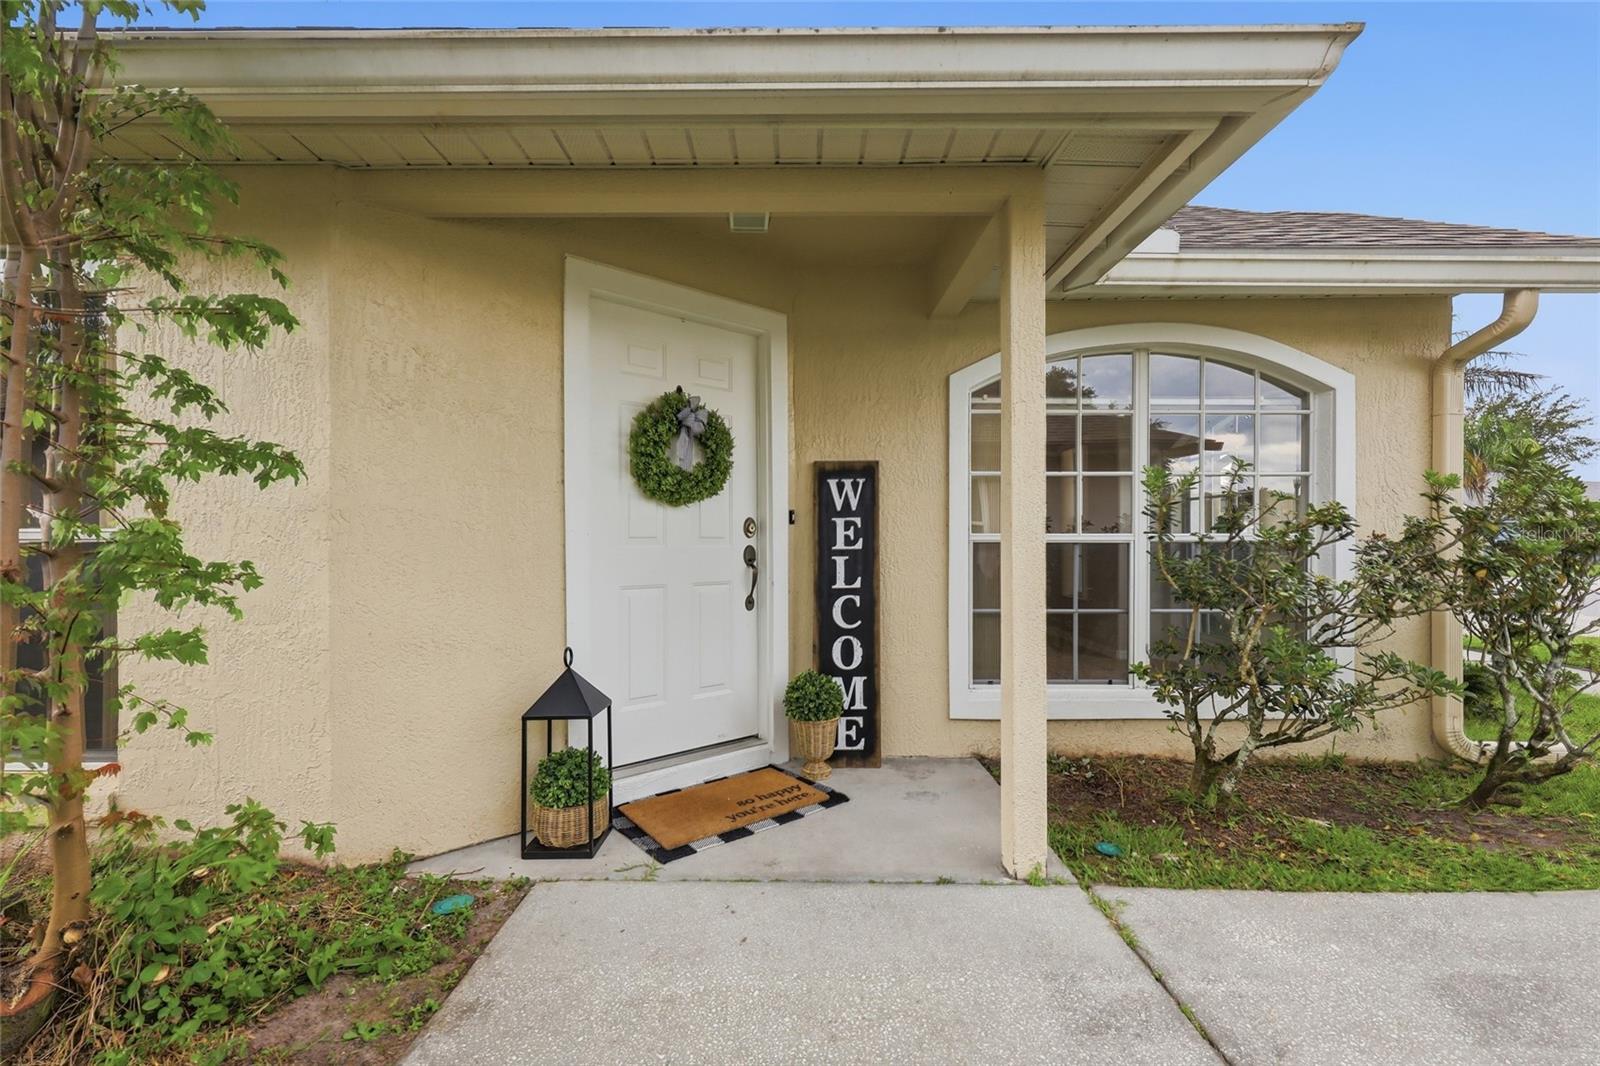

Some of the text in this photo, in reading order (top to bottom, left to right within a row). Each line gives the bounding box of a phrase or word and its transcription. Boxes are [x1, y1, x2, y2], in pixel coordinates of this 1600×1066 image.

[826, 477, 868, 751] WELCOME
[736, 784, 802, 807] so happy
[724, 803, 776, 822] you're
